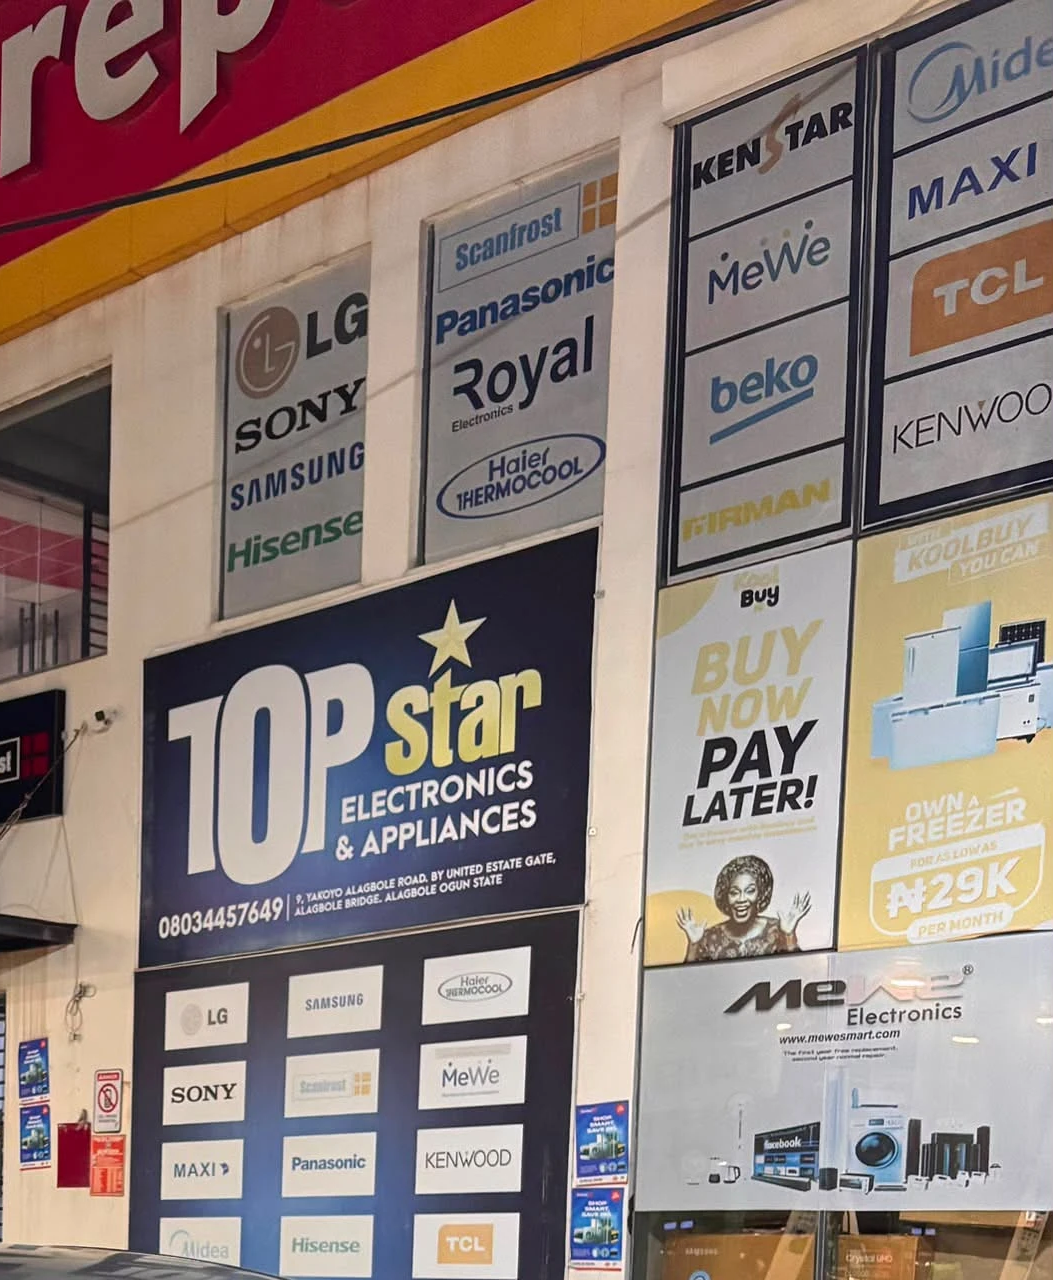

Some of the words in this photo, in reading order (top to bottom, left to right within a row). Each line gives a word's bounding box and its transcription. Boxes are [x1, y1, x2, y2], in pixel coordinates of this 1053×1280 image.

[692, 97, 853, 190] KENSTAR
[907, 141, 1038, 220] MAXI
[455, 207, 563, 272] Scanfrost
[707, 226, 831, 304] MeWe
[436, 254, 615, 345] Panasonic
[933, 257, 1045, 318] TCL
[306, 291, 369, 360] LG
[452, 314, 595, 411] Royal
[710, 353, 818, 414] beko
[234, 376, 367, 455] SONY
[451, 404, 514, 433] Electronics
[230, 440, 366, 512] SAMSUNG
[456, 456, 584, 511] THERMOCOOL
[487, 447, 550, 482] Haier
[682, 478, 830, 542] FIRMAN
[227, 508, 364, 573] Hisense
[740, 584, 780, 609] Buy
[690, 618, 825, 697] BUY
[695, 677, 814, 737] NOW
[167, 662, 376, 886] TOP
[695, 718, 820, 790] PAY
[340, 759, 535, 825] ELECTRONICS
[682, 774, 819, 827] LATER!
[904, 791, 964, 824] OWN
[968, 795, 980, 809] A
[335, 835, 355, 861] &
[360, 799, 538, 858] APPLIANCES
[888, 797, 1027, 852] FREEZER
[294, 901, 343, 917] ALAGBOLE
[384, 885, 437, 903] ALAGBOLE
[439, 878, 471, 894] OGUN
[472, 873, 504, 889] STATE
[307, 887, 343, 902] YAKOYO
[345, 878, 396, 896] ALAGBOLE
[431, 869, 445, 882] BY
[446, 863, 483, 880] UNITED
[486, 857, 523, 873] ESTATE
[524, 852, 556, 867] GATE,
[158, 896, 284, 940] 08034457649
[917, 921, 947, 939] PER
[949, 910, 1005, 932] MONTH
[207, 1007, 228, 1026] LG
[305, 992, 364, 1012] SAMSUNG
[847, 1003, 963, 1026] Electronics
[170, 1082, 238, 1104] SONY
[441, 1063, 500, 1088] MeWe
[173, 1161, 216, 1178] MAXI
[291, 1153, 367, 1171] Panasonic
[425, 1148, 512, 1170] KENWOOD
[764, 1135, 802, 1150] facebook
[182, 1241, 230, 1259] Midea
[291, 1236, 361, 1254] Hisense
[446, 1236, 486, 1252] TCL
